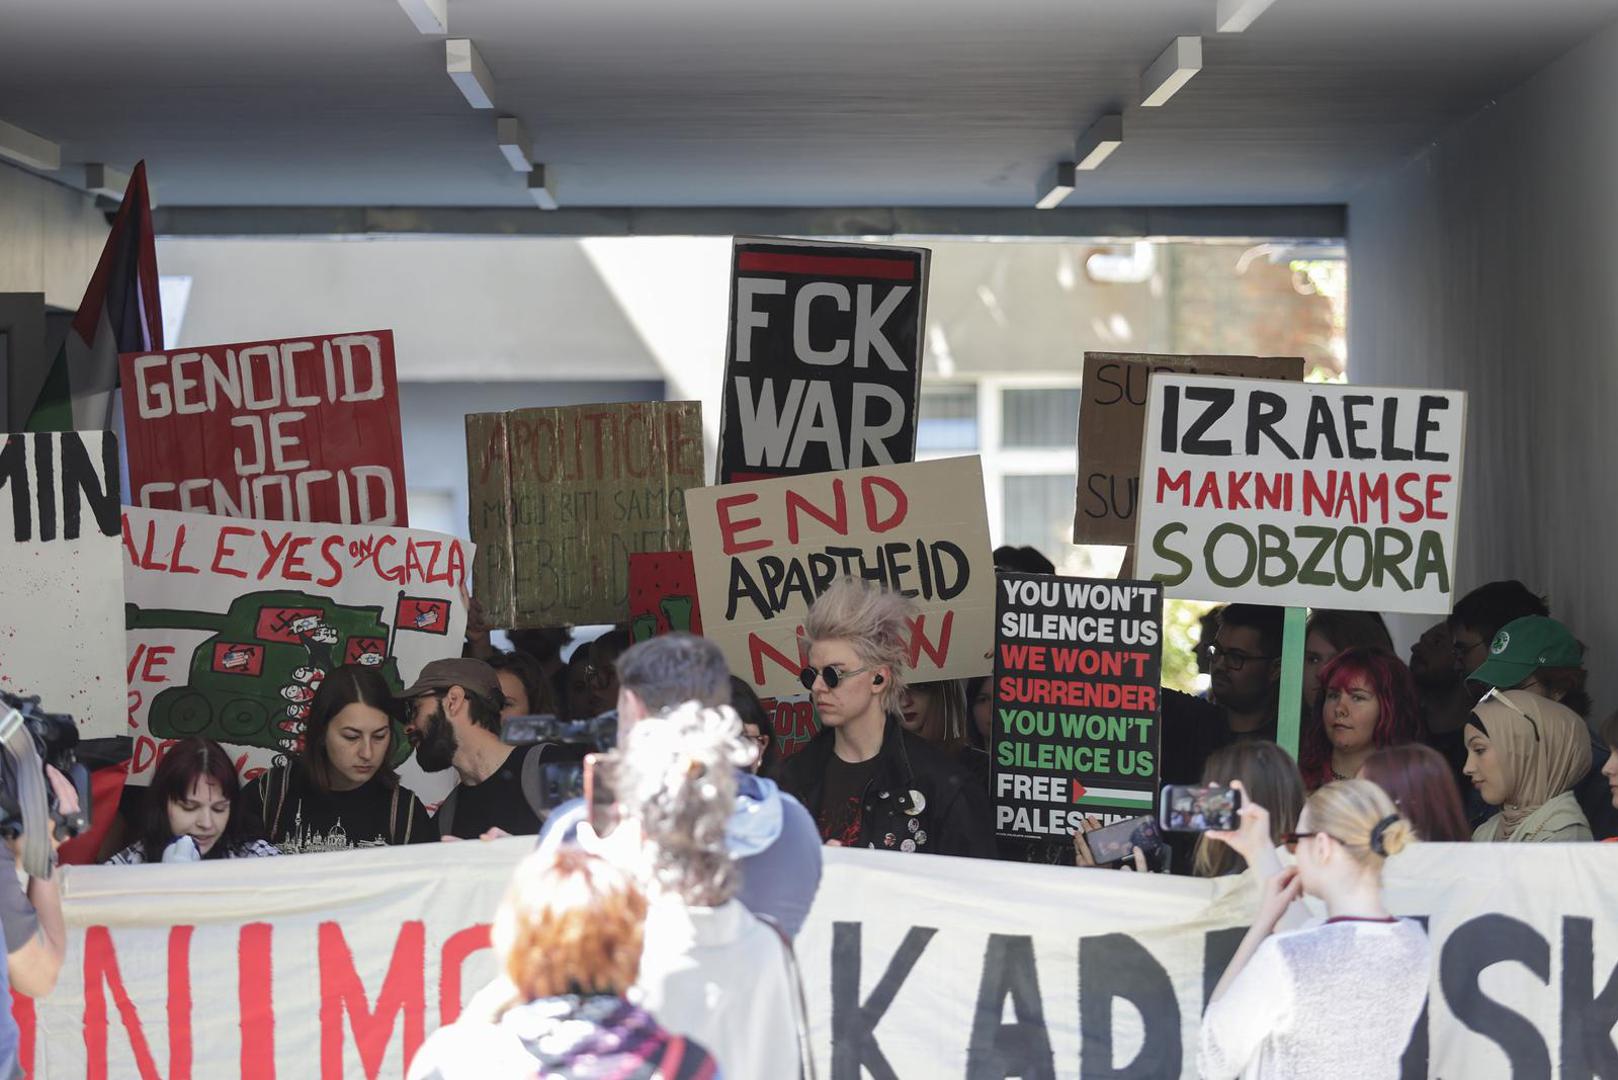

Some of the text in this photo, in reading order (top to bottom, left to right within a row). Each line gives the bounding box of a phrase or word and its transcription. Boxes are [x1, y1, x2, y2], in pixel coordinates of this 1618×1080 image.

[735, 277, 912, 371] FCK
[134, 334, 385, 419] GENOCID
[231, 411, 310, 475] JE
[734, 376, 905, 470] WAR
[1161, 385, 1450, 461] IZRAELE
[481, 486, 685, 530] MOGU BITI SAMO
[716, 476, 908, 556] END
[1156, 467, 1452, 524] MAKNI NAM SE
[211, 526, 345, 588] EYES
[348, 534, 374, 564] ON
[373, 534, 466, 588] GAZA
[725, 538, 970, 620] APARTHEID
[1151, 522, 1449, 593] S OBZORA
[1003, 579, 1157, 613] YOU WON'T
[749, 610, 954, 685] NW
[1001, 611, 1158, 646] SILENCE US
[1000, 644, 1150, 677] WE WON'T
[1000, 676, 1156, 711] SURRENDER
[999, 708, 1153, 744] YOU WON'T
[997, 773, 1068, 803] FREE
[998, 741, 1154, 777] SILENCE US
